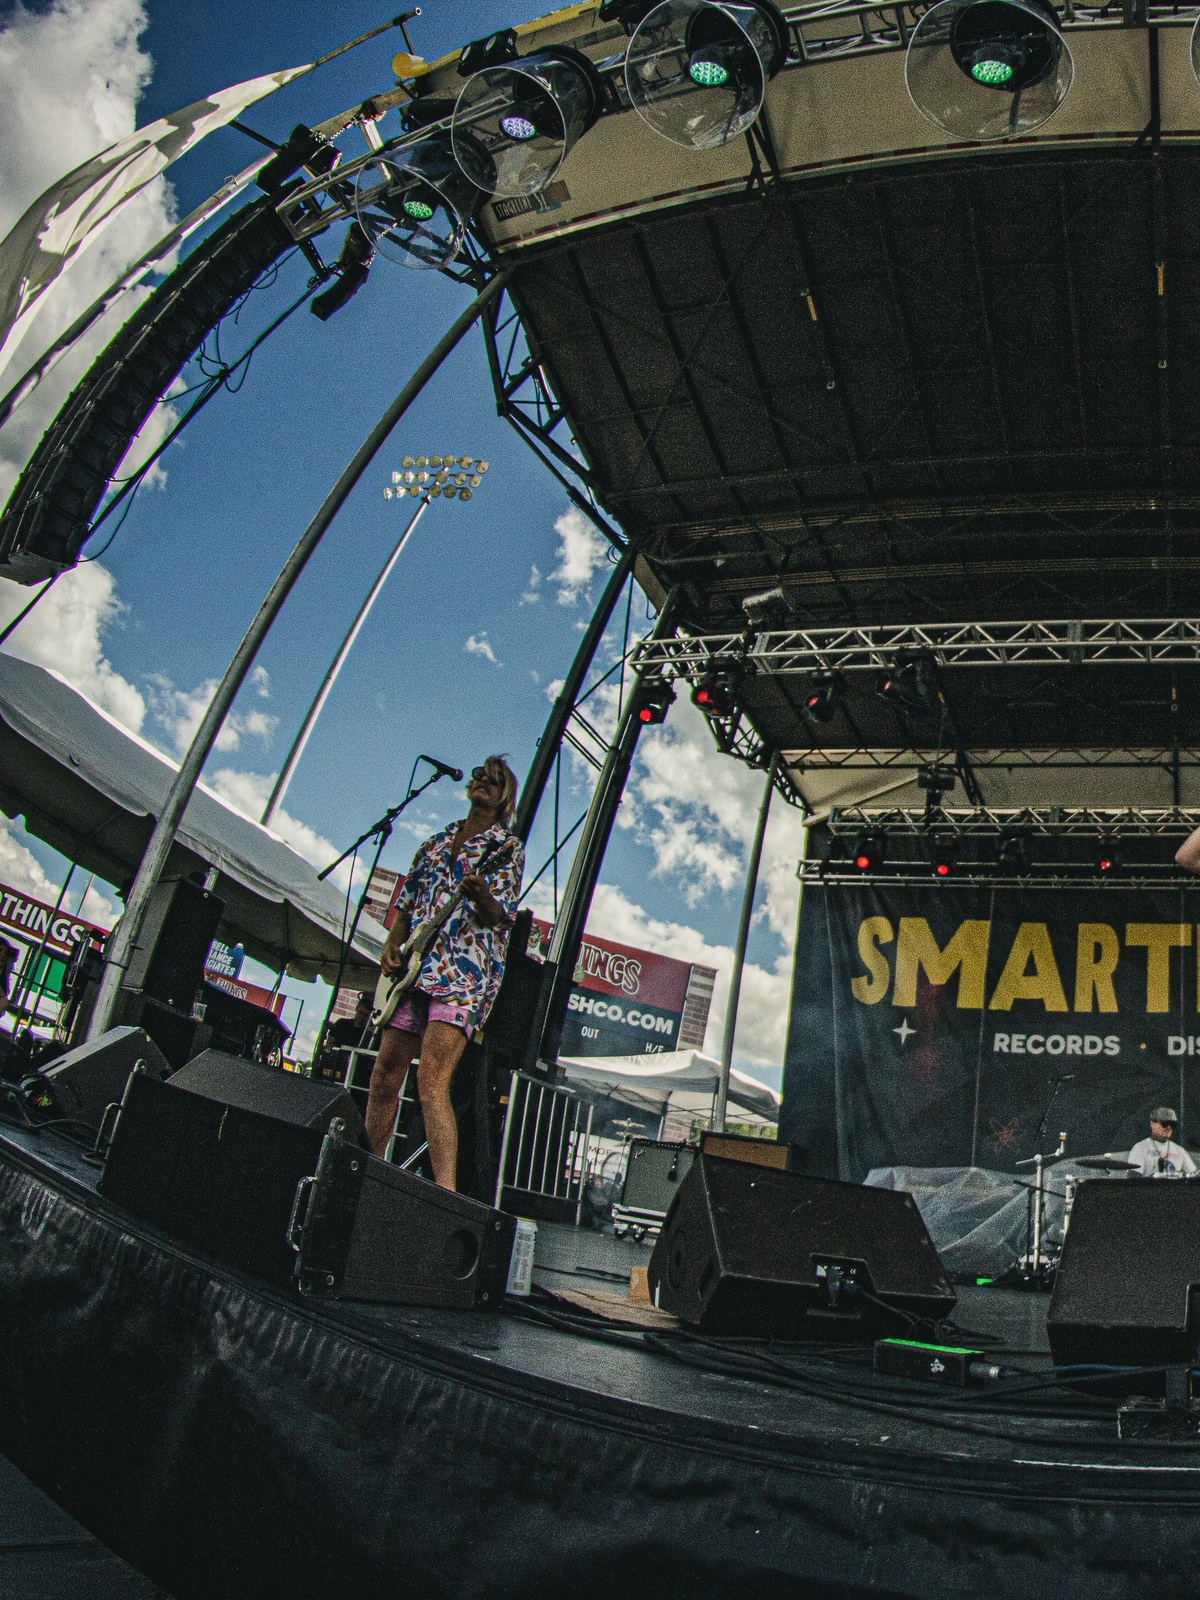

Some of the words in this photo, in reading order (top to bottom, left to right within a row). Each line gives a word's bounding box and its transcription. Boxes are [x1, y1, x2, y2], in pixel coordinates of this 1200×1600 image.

[496, 195, 532, 218] STAGELINE
[0, 888, 85, 947] THINGS
[206, 959, 236, 977] CIATES
[579, 941, 642, 995] INGS
[581, 1025, 600, 1039] OUT
[993, 1032, 1121, 1056] RECORDS
